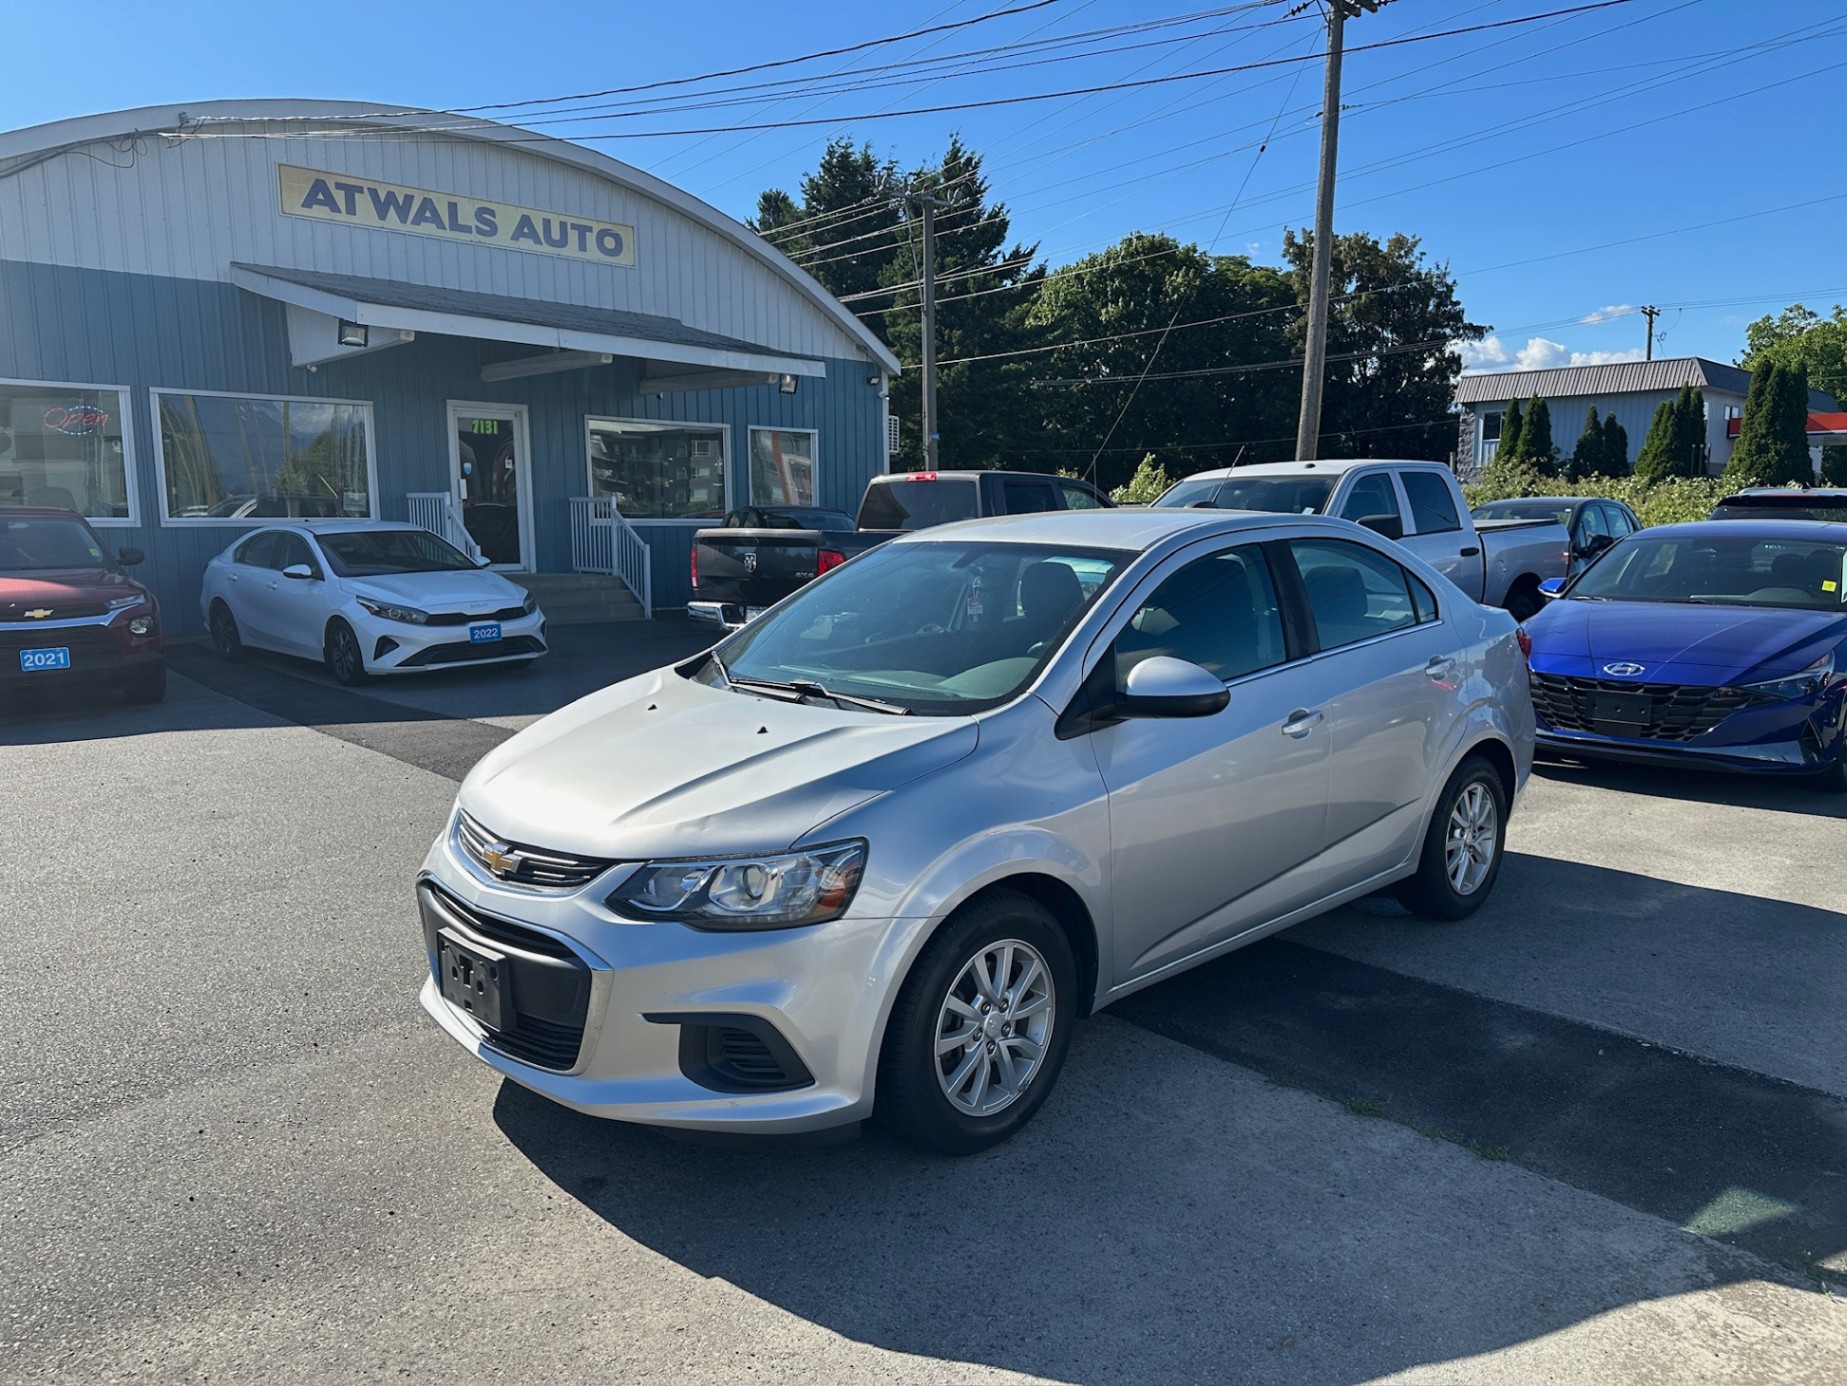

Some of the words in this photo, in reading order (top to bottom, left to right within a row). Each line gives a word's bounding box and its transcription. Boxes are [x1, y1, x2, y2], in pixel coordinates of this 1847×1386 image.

[301, 178, 498, 238] ATWALS
[510, 214, 624, 257] AUTO
[43, 407, 109, 429] Open
[472, 419, 498, 435] 7131
[473, 628, 498, 639] 2022
[23, 652, 64, 667] 2021
